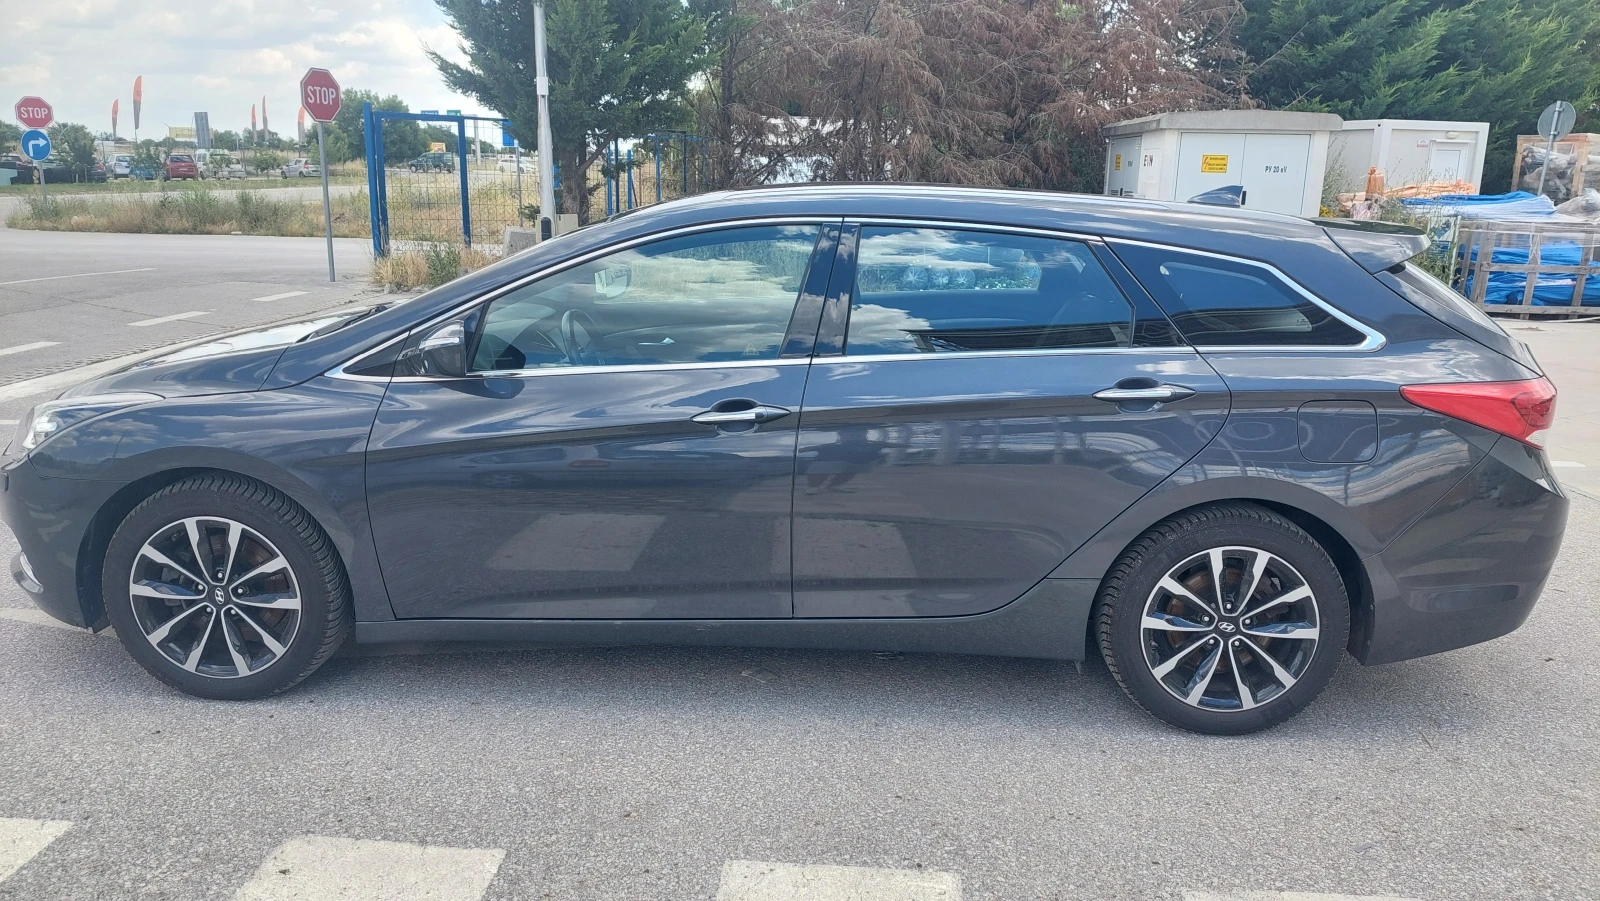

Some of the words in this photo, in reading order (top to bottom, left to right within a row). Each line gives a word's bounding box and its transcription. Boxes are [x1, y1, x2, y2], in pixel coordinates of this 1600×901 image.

[307, 85, 336, 105] STOP
[20, 106, 48, 119] STOP
[1273, 165, 1280, 173] 20
